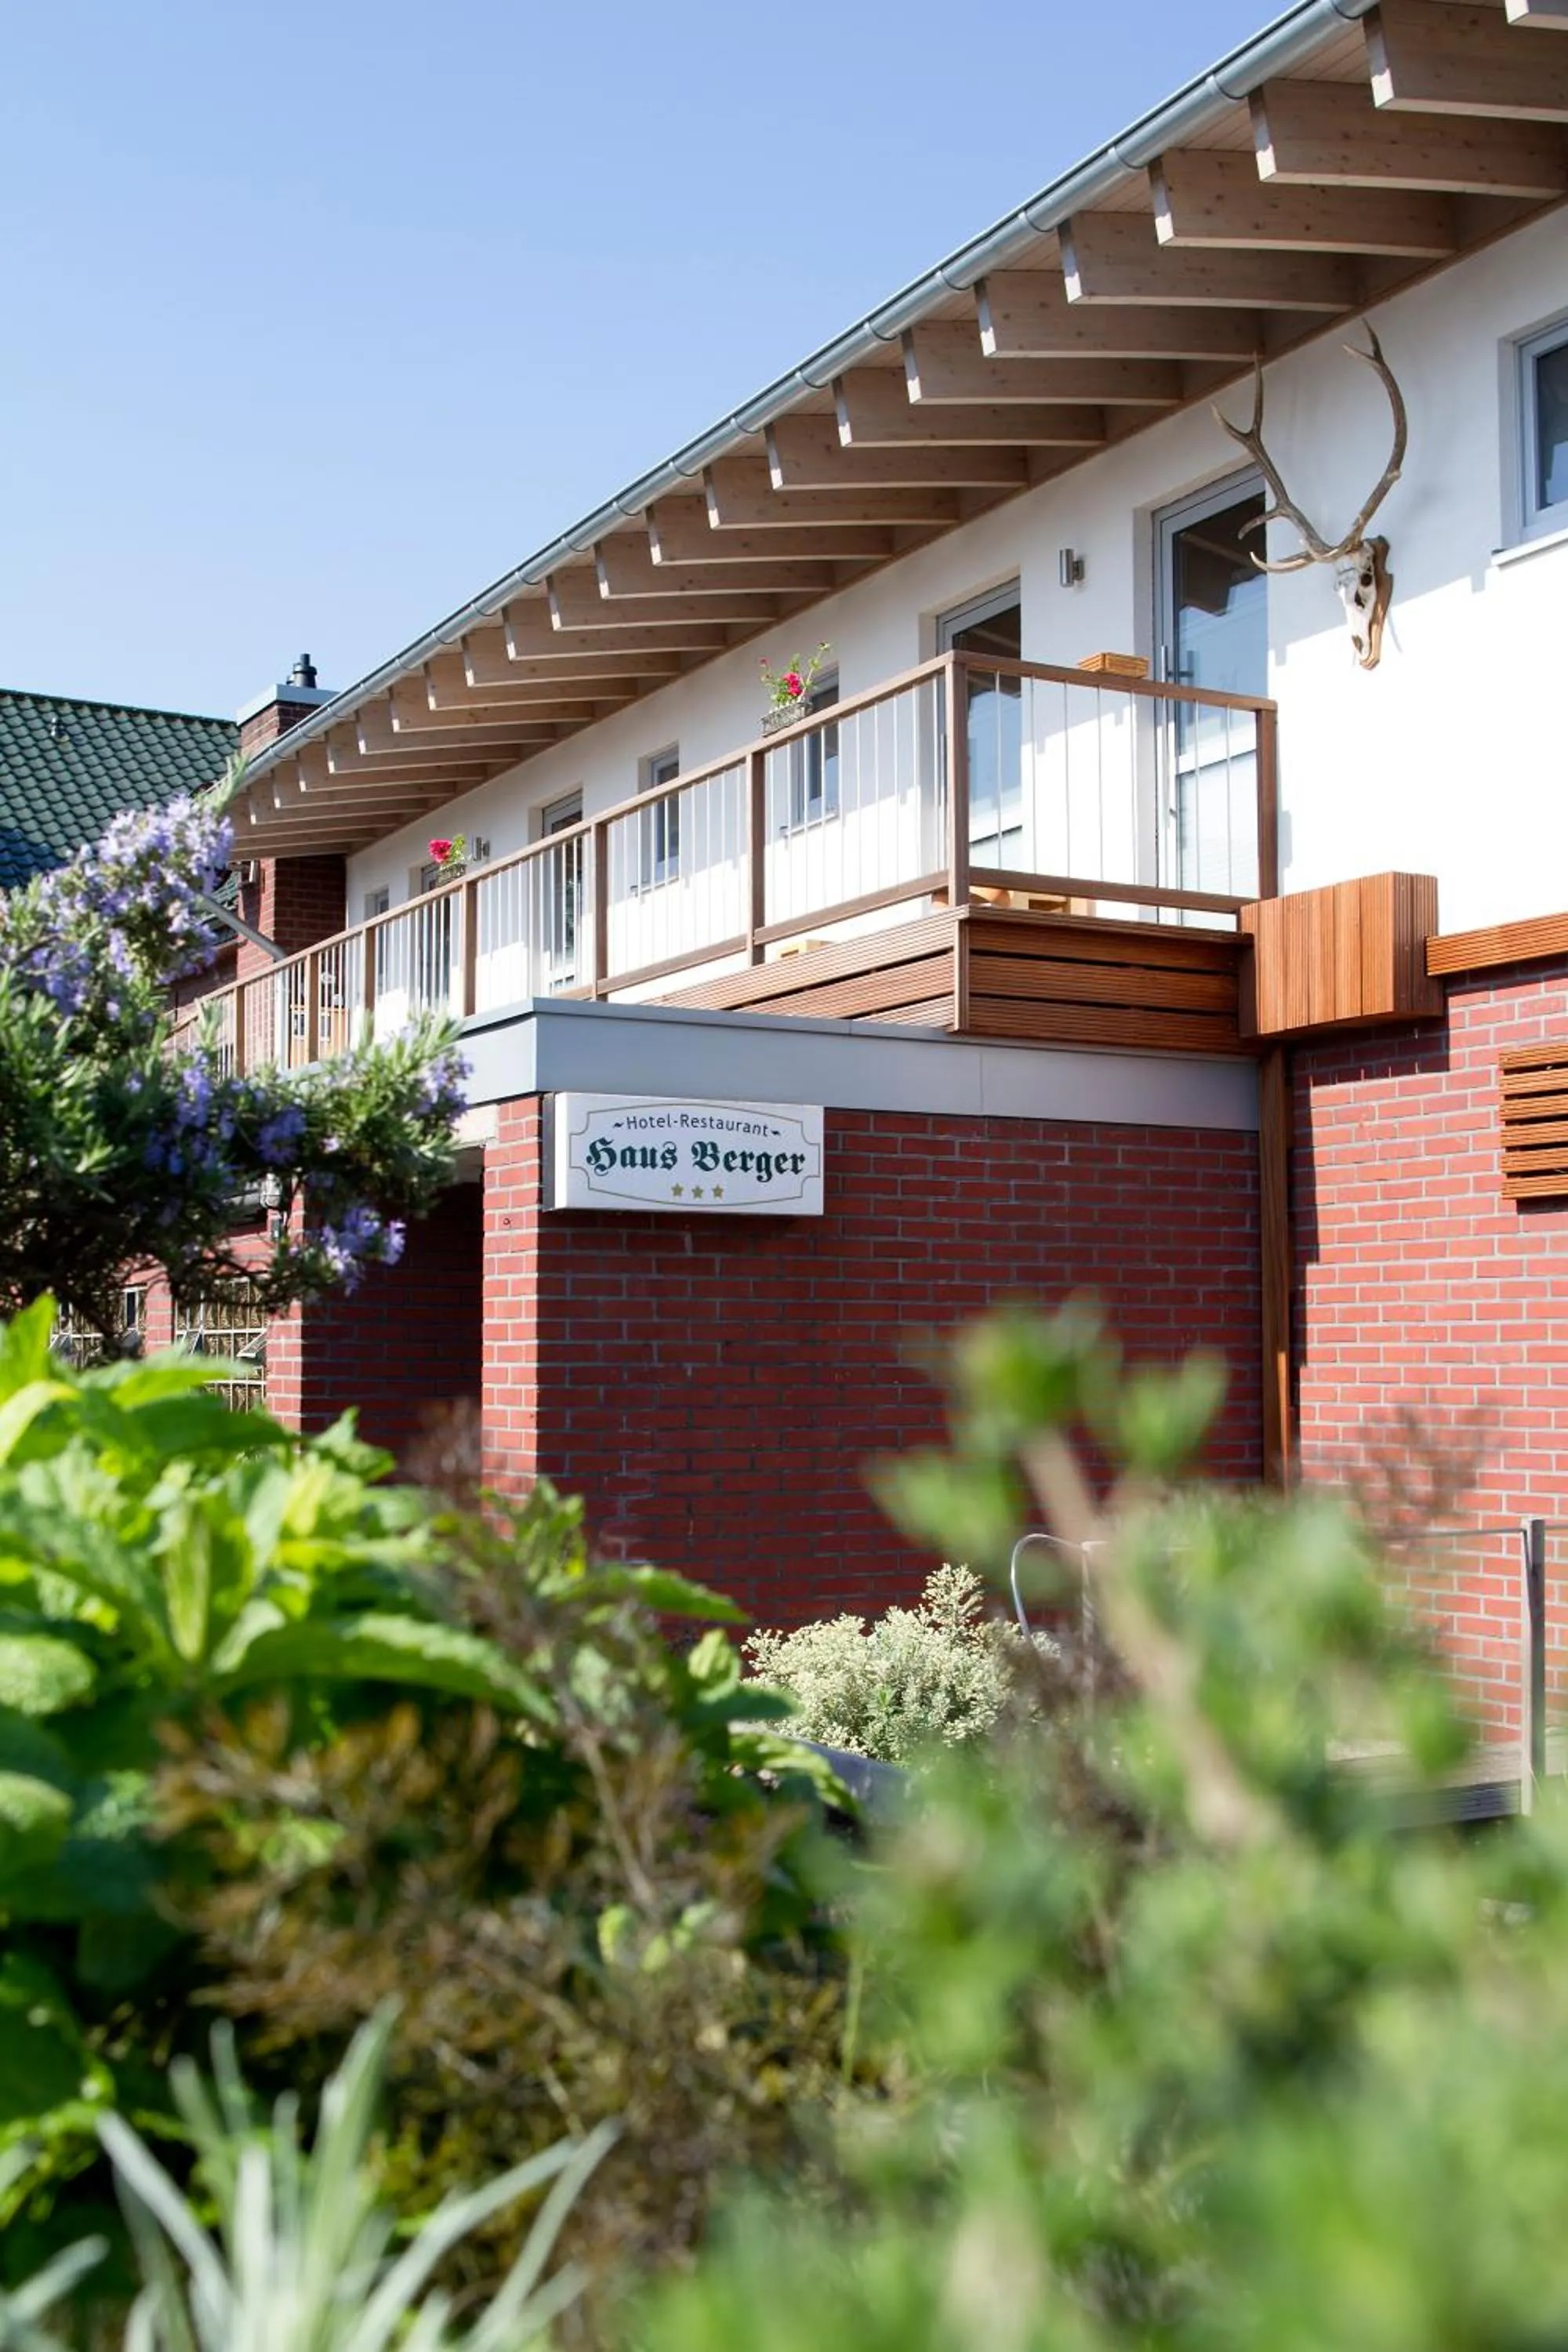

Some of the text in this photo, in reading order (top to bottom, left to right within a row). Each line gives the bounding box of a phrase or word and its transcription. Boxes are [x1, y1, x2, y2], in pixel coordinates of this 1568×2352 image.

[626, 1113, 768, 1137] Hotel-Restaurant
[586, 1137, 806, 1182] Haus Berger
